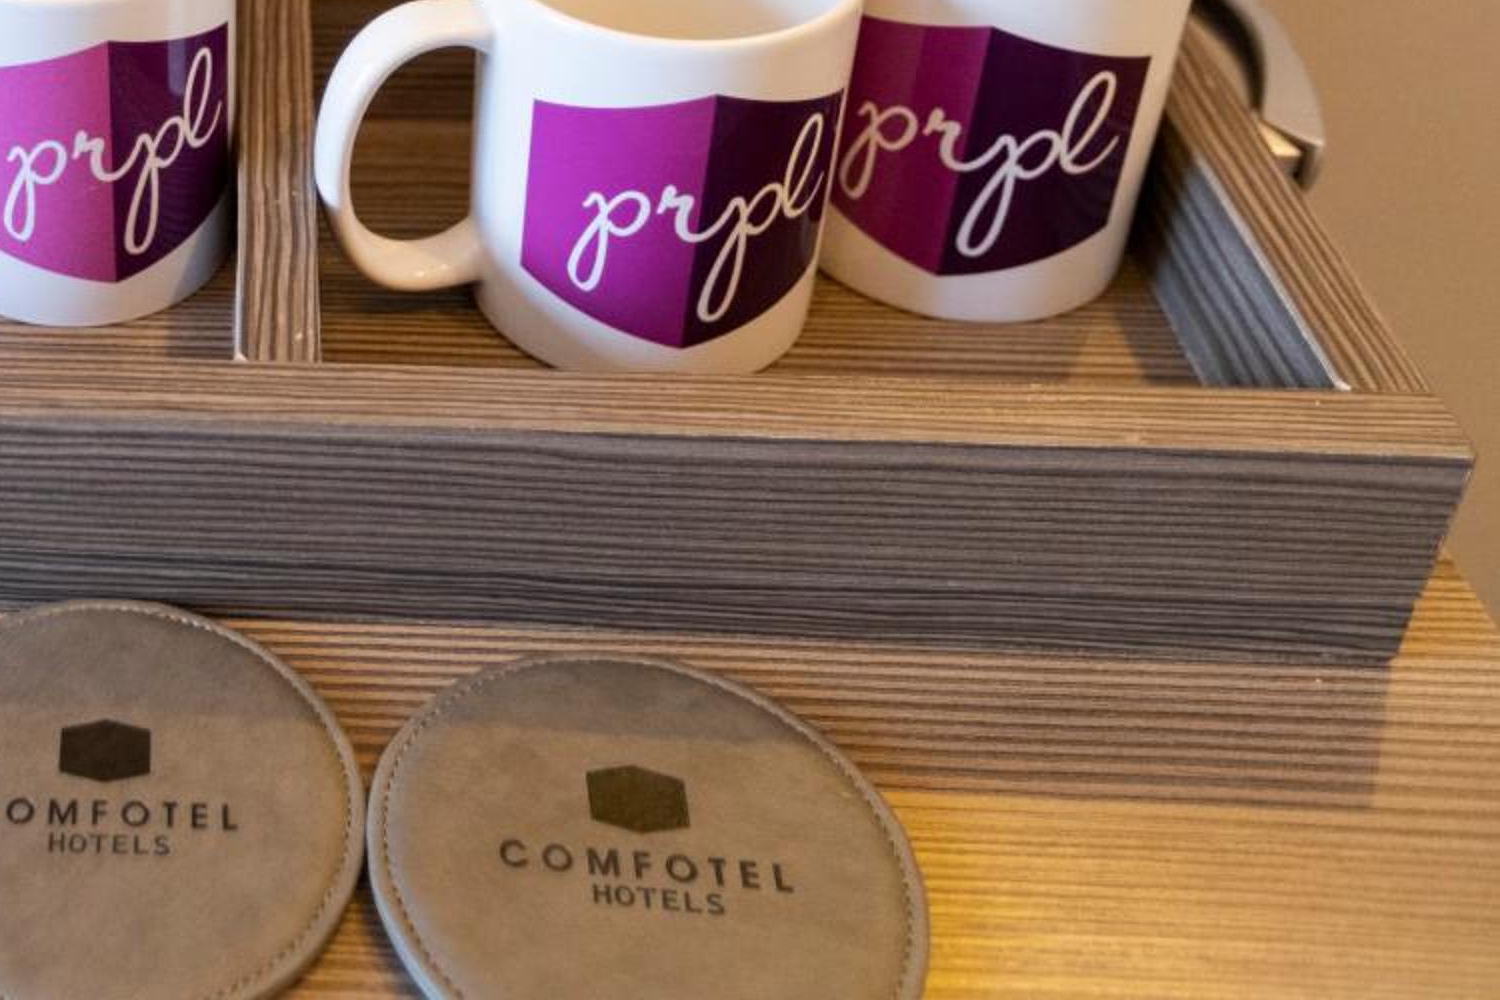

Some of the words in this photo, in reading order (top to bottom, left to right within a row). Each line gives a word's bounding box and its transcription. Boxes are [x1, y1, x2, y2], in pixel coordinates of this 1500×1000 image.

[3, 47, 223, 256] prpl
[838, 70, 1120, 258] prpl
[567, 112, 825, 323] prpl
[49, 832, 172, 856] HOTELS
[500, 839, 795, 894] COMFOTEL
[592, 884, 726, 916] HOTELS
